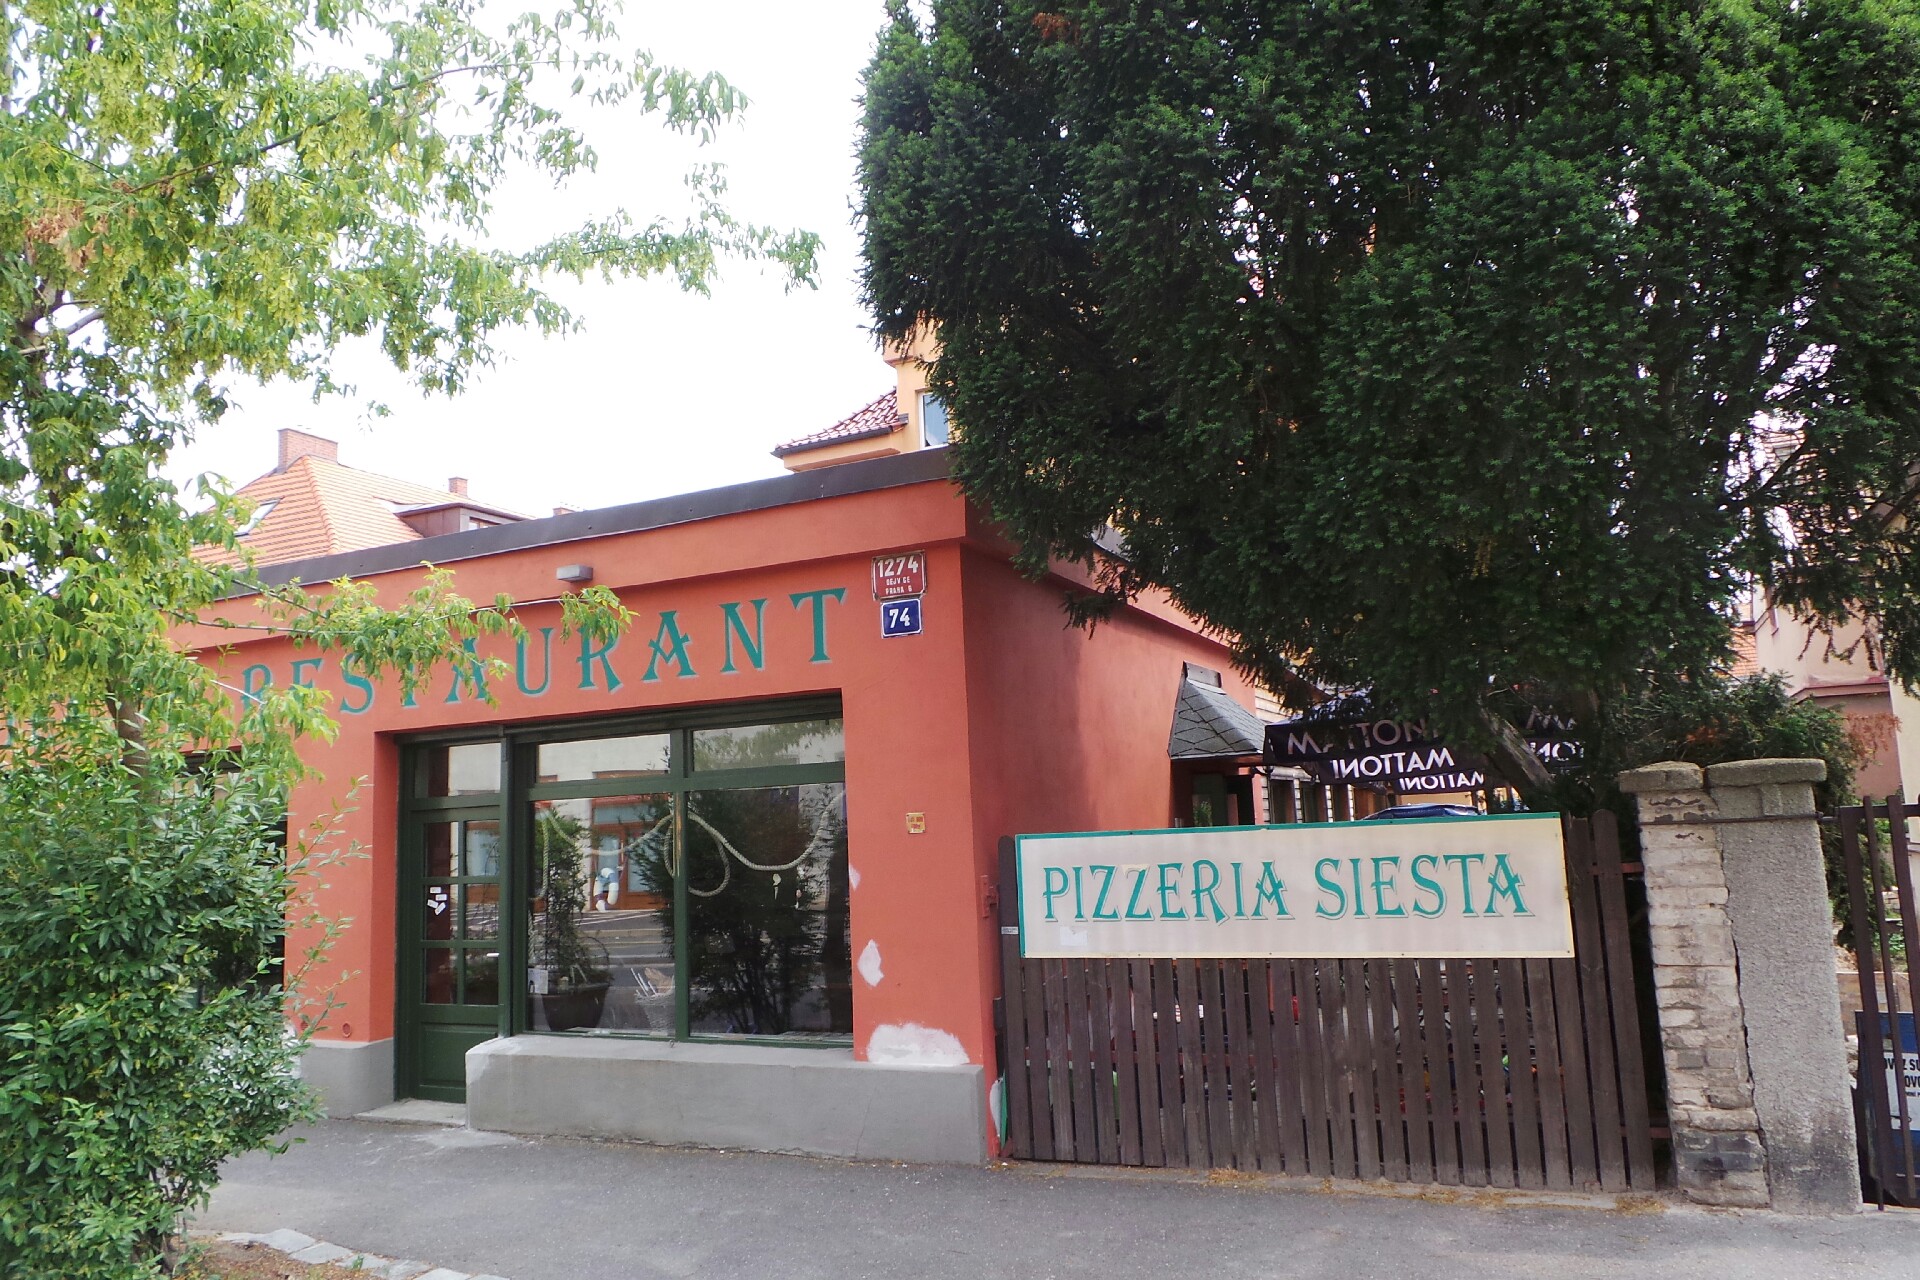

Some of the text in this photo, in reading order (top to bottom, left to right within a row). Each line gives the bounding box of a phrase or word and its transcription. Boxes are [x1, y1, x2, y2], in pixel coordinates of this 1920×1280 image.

[878, 556, 918, 577] 1274
[885, 587, 905, 596] PRAHA
[886, 576, 911, 586] DEJVCE
[889, 607, 910, 629] 74
[1043, 853, 1535, 925] PIZZERIA SIESTA
